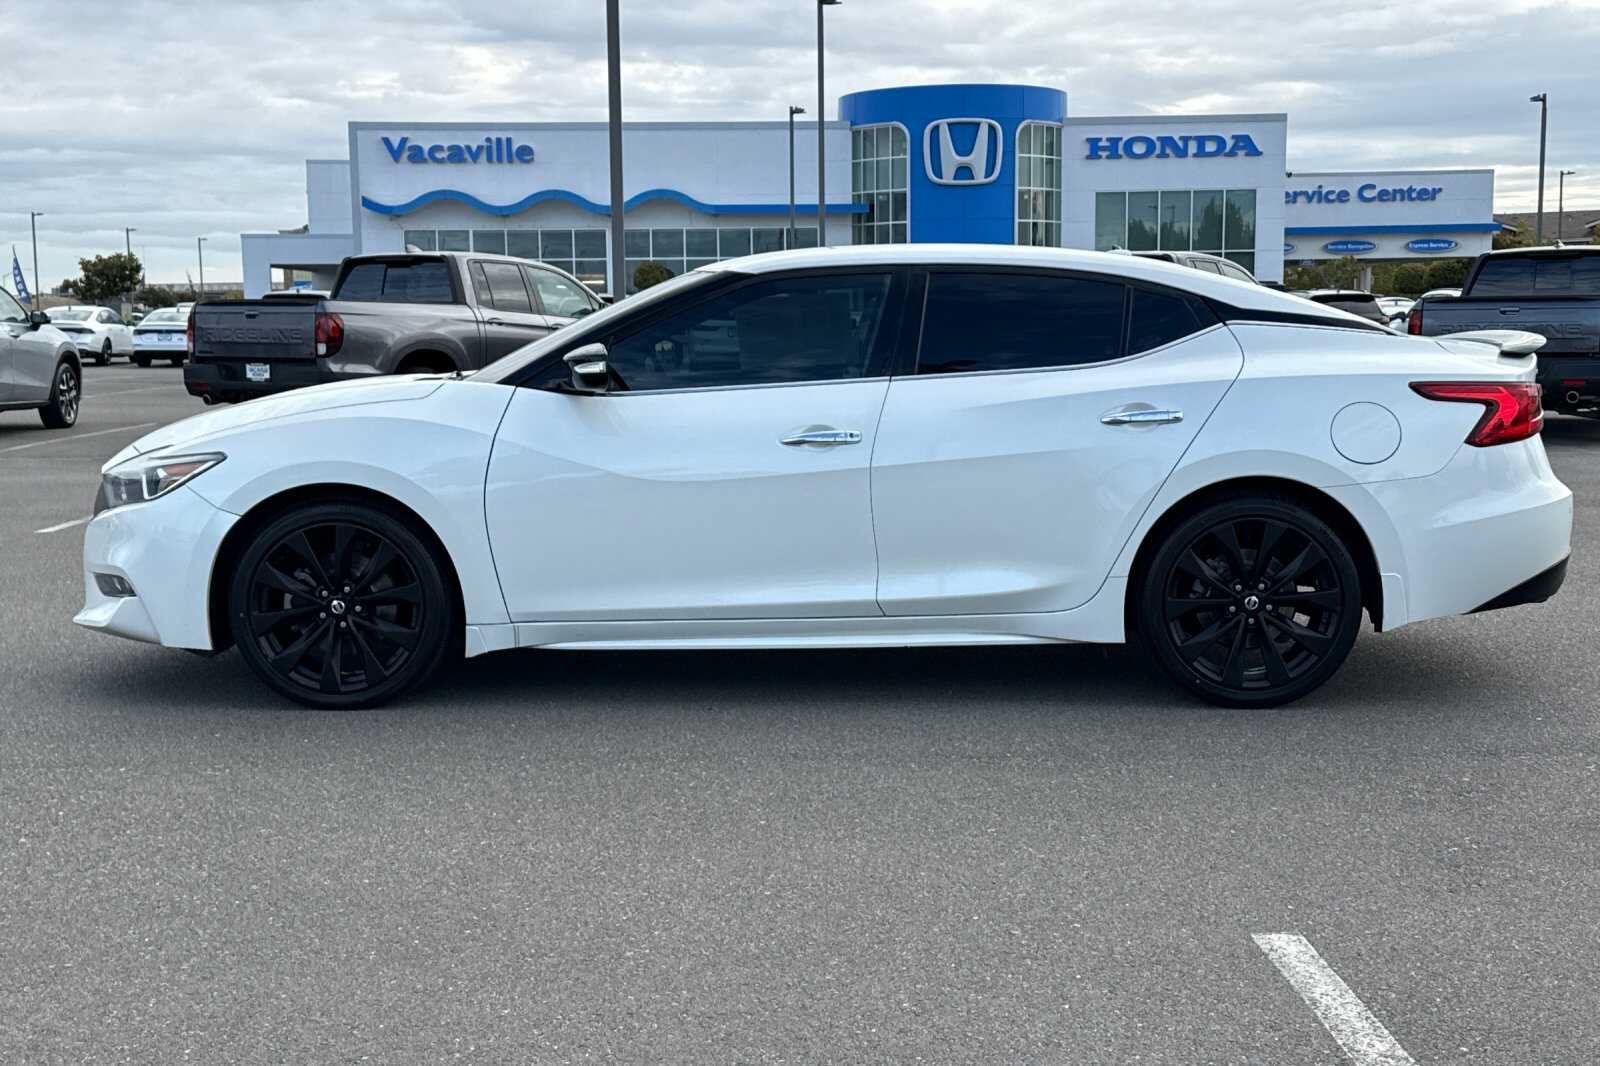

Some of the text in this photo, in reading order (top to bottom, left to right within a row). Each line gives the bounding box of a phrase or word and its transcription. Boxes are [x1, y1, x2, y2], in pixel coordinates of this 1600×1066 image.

[381, 136, 535, 164] Vacaville
[1085, 134, 1264, 161] HONDA
[1357, 183, 1443, 203] Center
[203, 327, 304, 344] RIDGELINE
